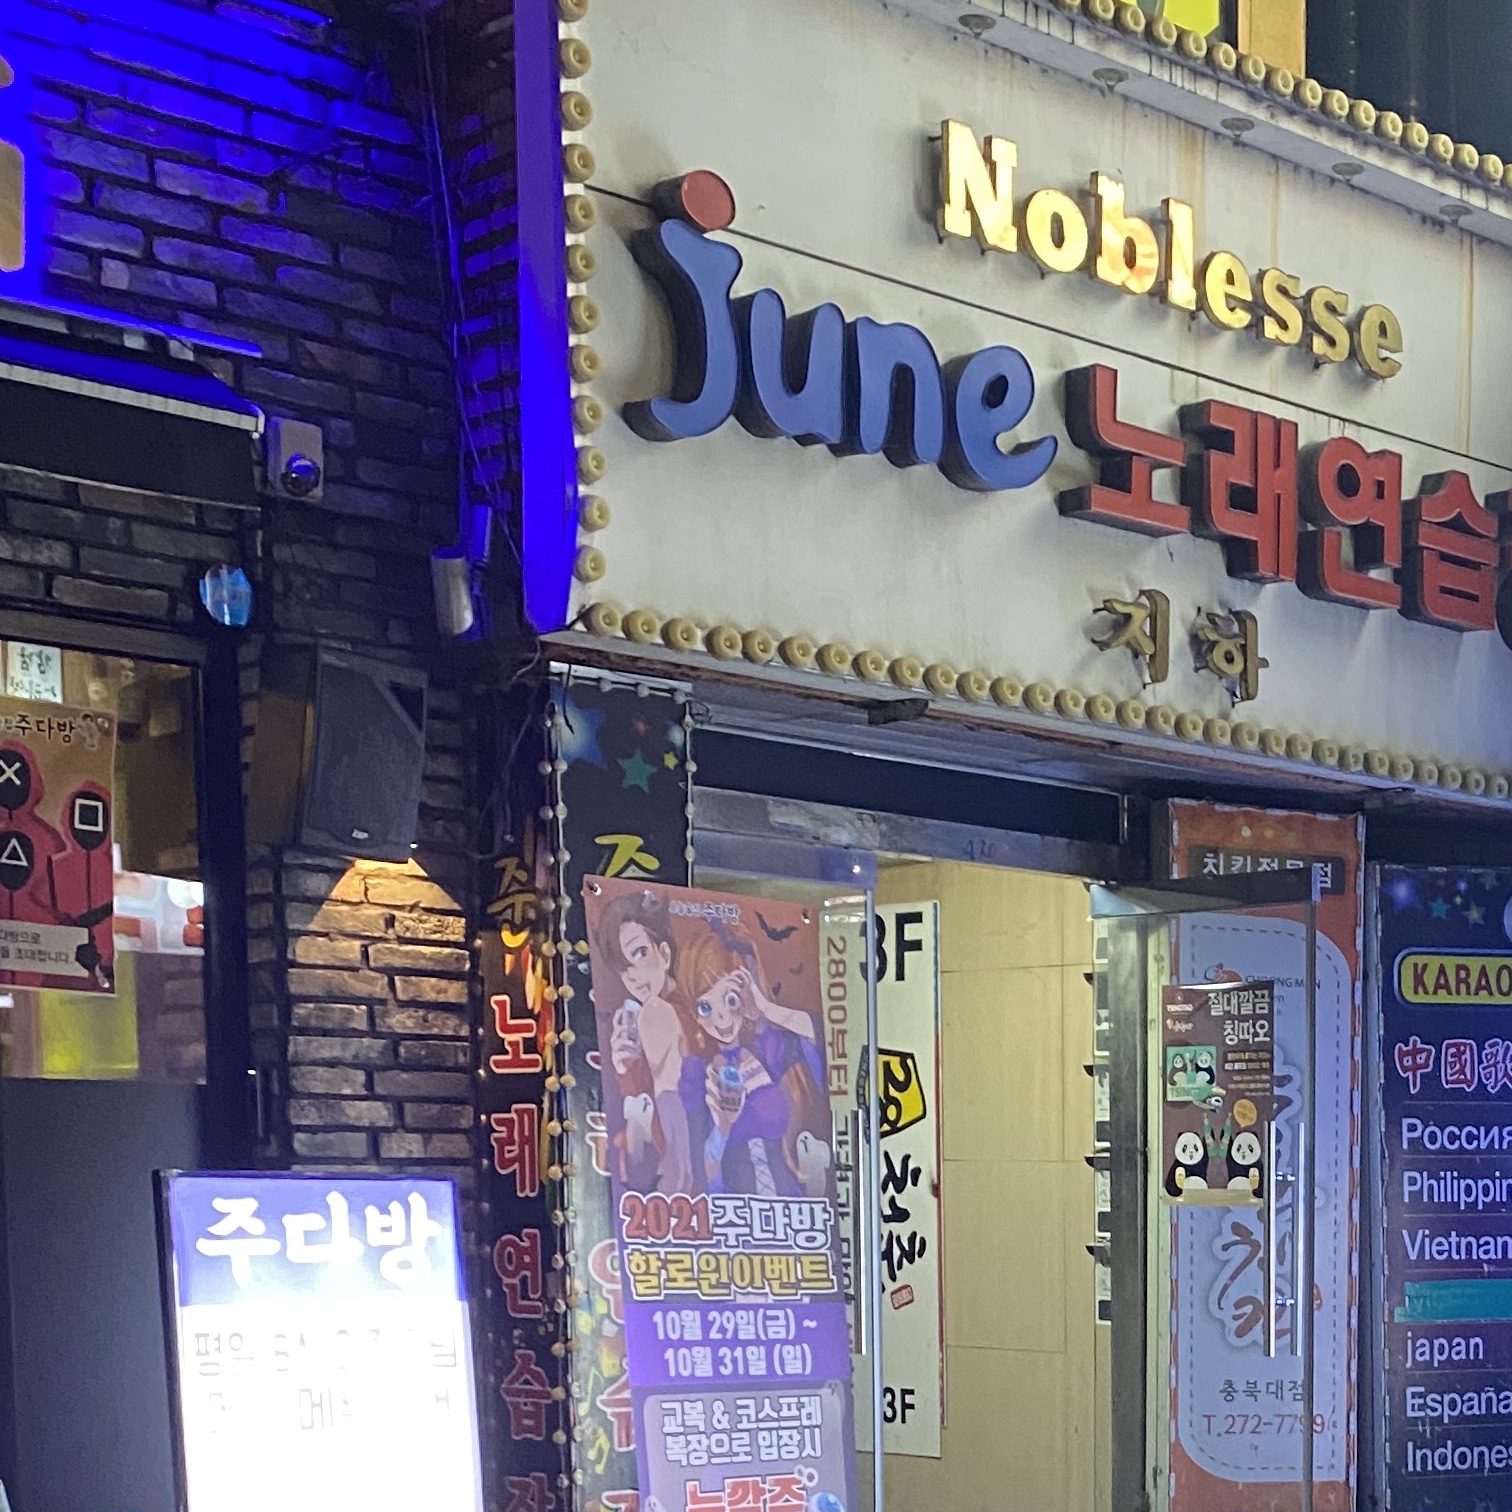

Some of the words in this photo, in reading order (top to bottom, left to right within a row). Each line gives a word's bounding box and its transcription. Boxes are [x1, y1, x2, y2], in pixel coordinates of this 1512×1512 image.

[941, 119, 1403, 379] Noblesse
[15, 713, 76, 743] 주다방
[859, 912, 923, 984] 3F
[827, 935, 847, 1096] 2800부터
[1224, 1020, 1270, 1045] 칭따오
[195, 1191, 442, 1288] 주다방
[626, 1248, 837, 1299] 할로윈이벤트
[653, 1310, 702, 1341] 10월
[708, 1308, 795, 1341] 29일(금)
[664, 1346, 713, 1378] 10월
[718, 1345, 767, 1376] 31일
[1406, 1331, 1484, 1368] japan
[883, 1387, 915, 1424] 3F
[1219, 1379, 1304, 1402] 충북대점
[661, 1401, 705, 1434] 교복
[712, 1400, 730, 1430] &
[736, 1396, 822, 1430] 코스프레
[665, 1432, 752, 1466] 복장으로
